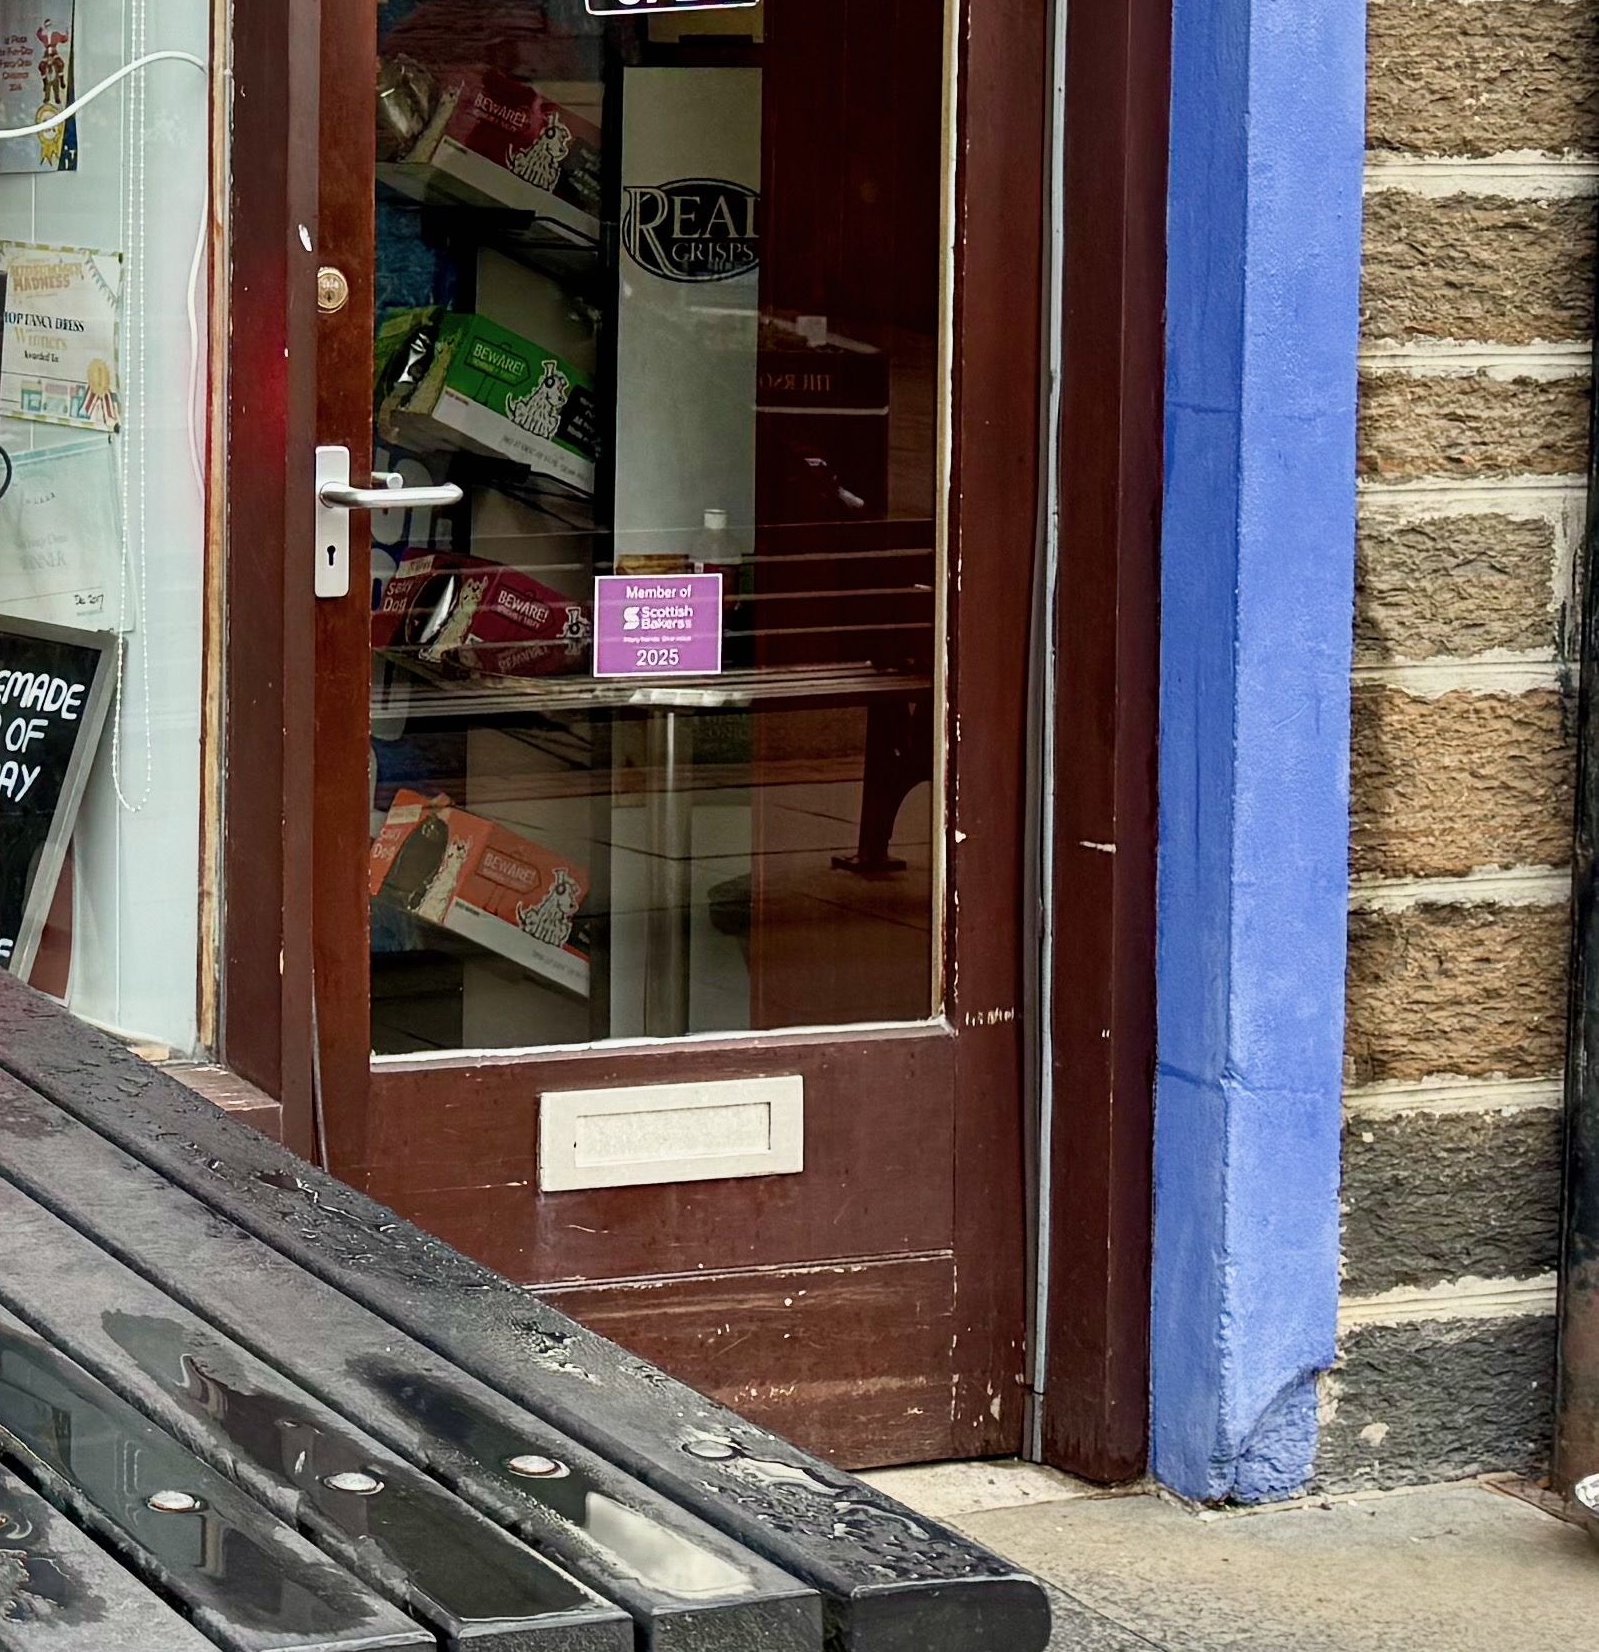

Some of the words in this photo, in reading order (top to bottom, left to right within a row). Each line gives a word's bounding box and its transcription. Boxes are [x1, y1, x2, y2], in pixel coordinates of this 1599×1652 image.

[473, 342, 526, 377] BEWARE!
[626, 585, 677, 598] Member
[679, 584, 692, 598] of
[498, 589, 549, 625] BEWARE!
[641, 605, 694, 619] Scottish
[641, 618, 685, 630] Bakers
[636, 648, 680, 666] 2025
[5, 717, 49, 753] OF
